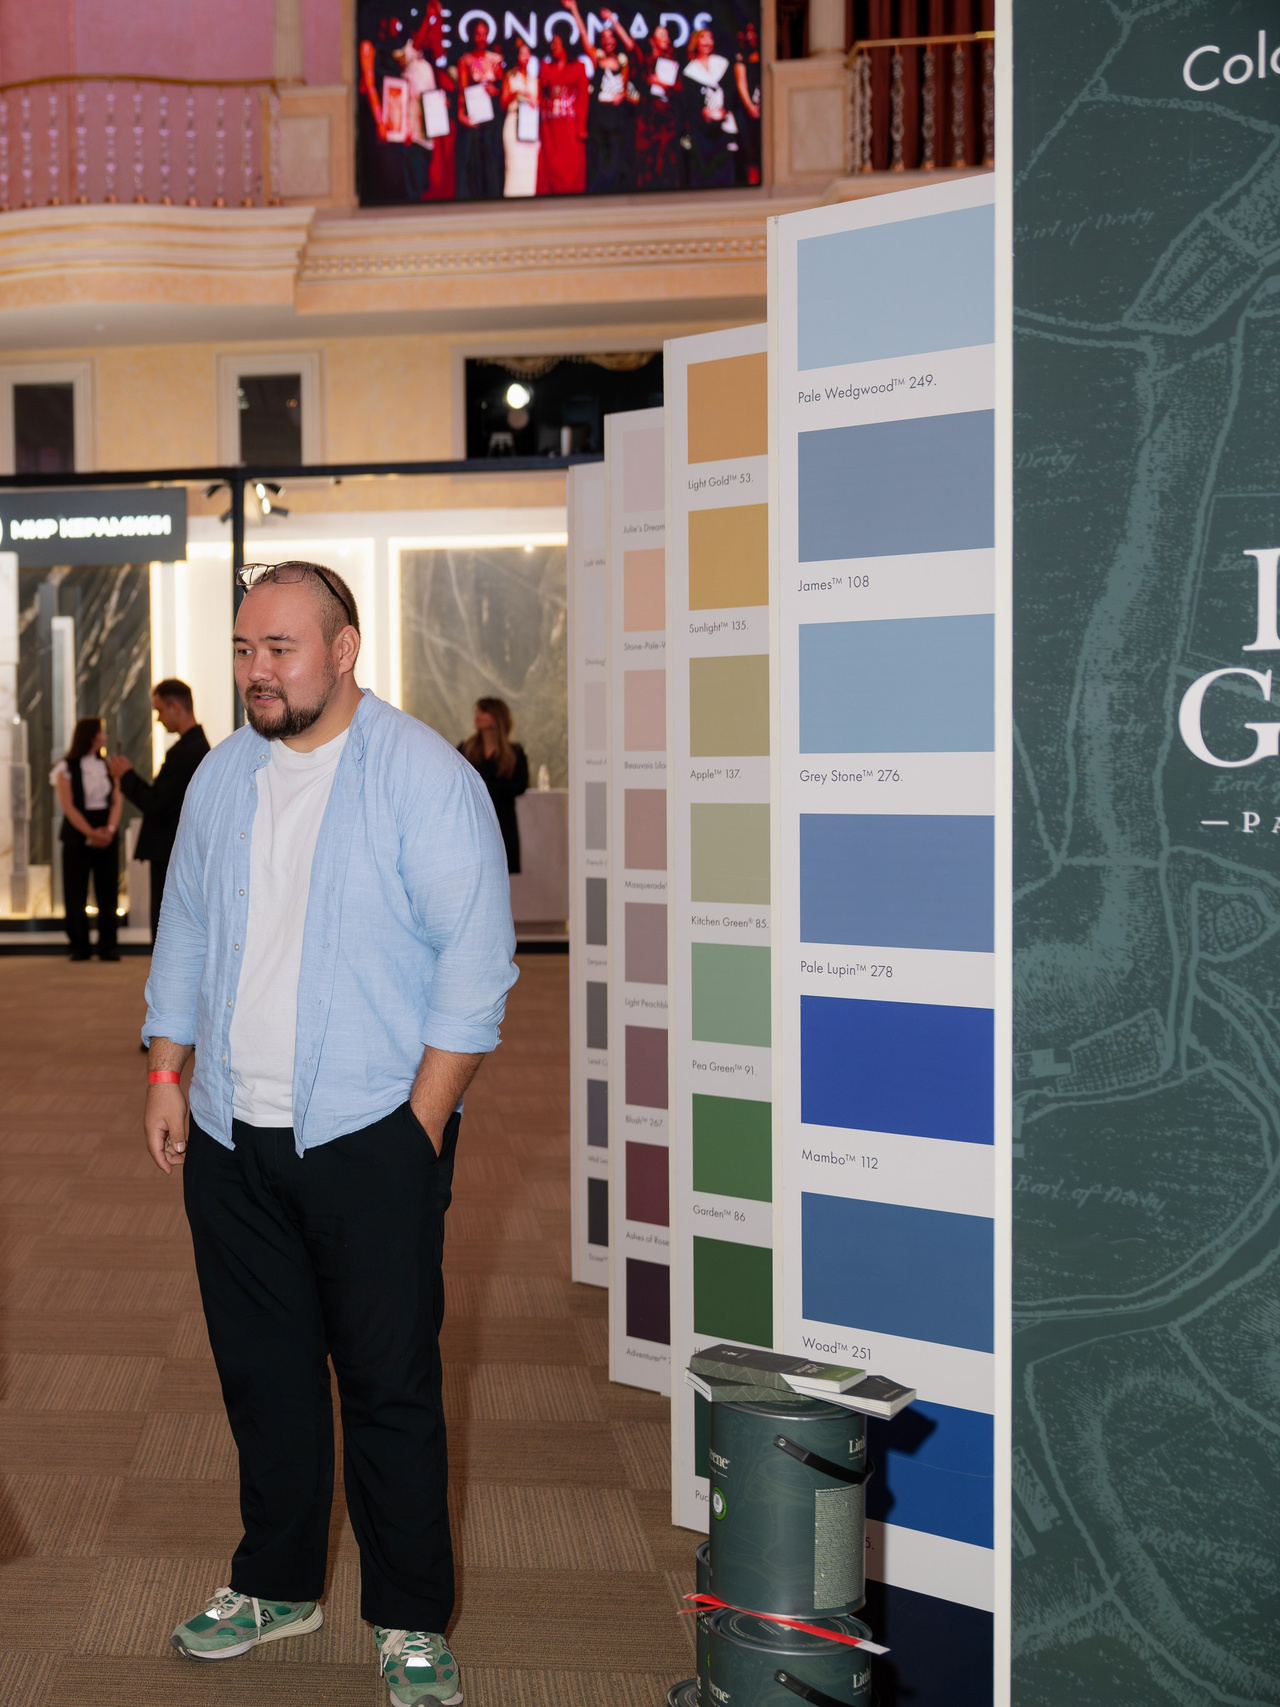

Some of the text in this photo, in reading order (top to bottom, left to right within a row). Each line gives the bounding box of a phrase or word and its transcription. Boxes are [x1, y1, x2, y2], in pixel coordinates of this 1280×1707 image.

[798, 388, 821, 404] Pale
[909, 373, 937, 389] 249.
[688, 479, 707, 491] Light
[739, 472, 754, 484] 53.
[847, 575, 870, 588] 108
[731, 620, 749, 631] 135.
[654, 761, 666, 769] Lila
[725, 768, 742, 779] 137.
[799, 769, 828, 785] Grey
[877, 769, 904, 783] 276.
[691, 916, 720, 927] Kitchen
[755, 918, 769, 929] 85.
[800, 961, 824, 974] Pale
[870, 964, 893, 978] 278
[624, 997, 640, 1008] Light
[692, 1060, 707, 1071] Pea
[744, 1065, 758, 1076] 91.
[861, 1155, 879, 1170] 112
[733, 1211, 746, 1222] 86
[625, 1232, 644, 1243] Ashes
[851, 1345, 872, 1361] 251
[695, 1489, 709, 1503] Puc
